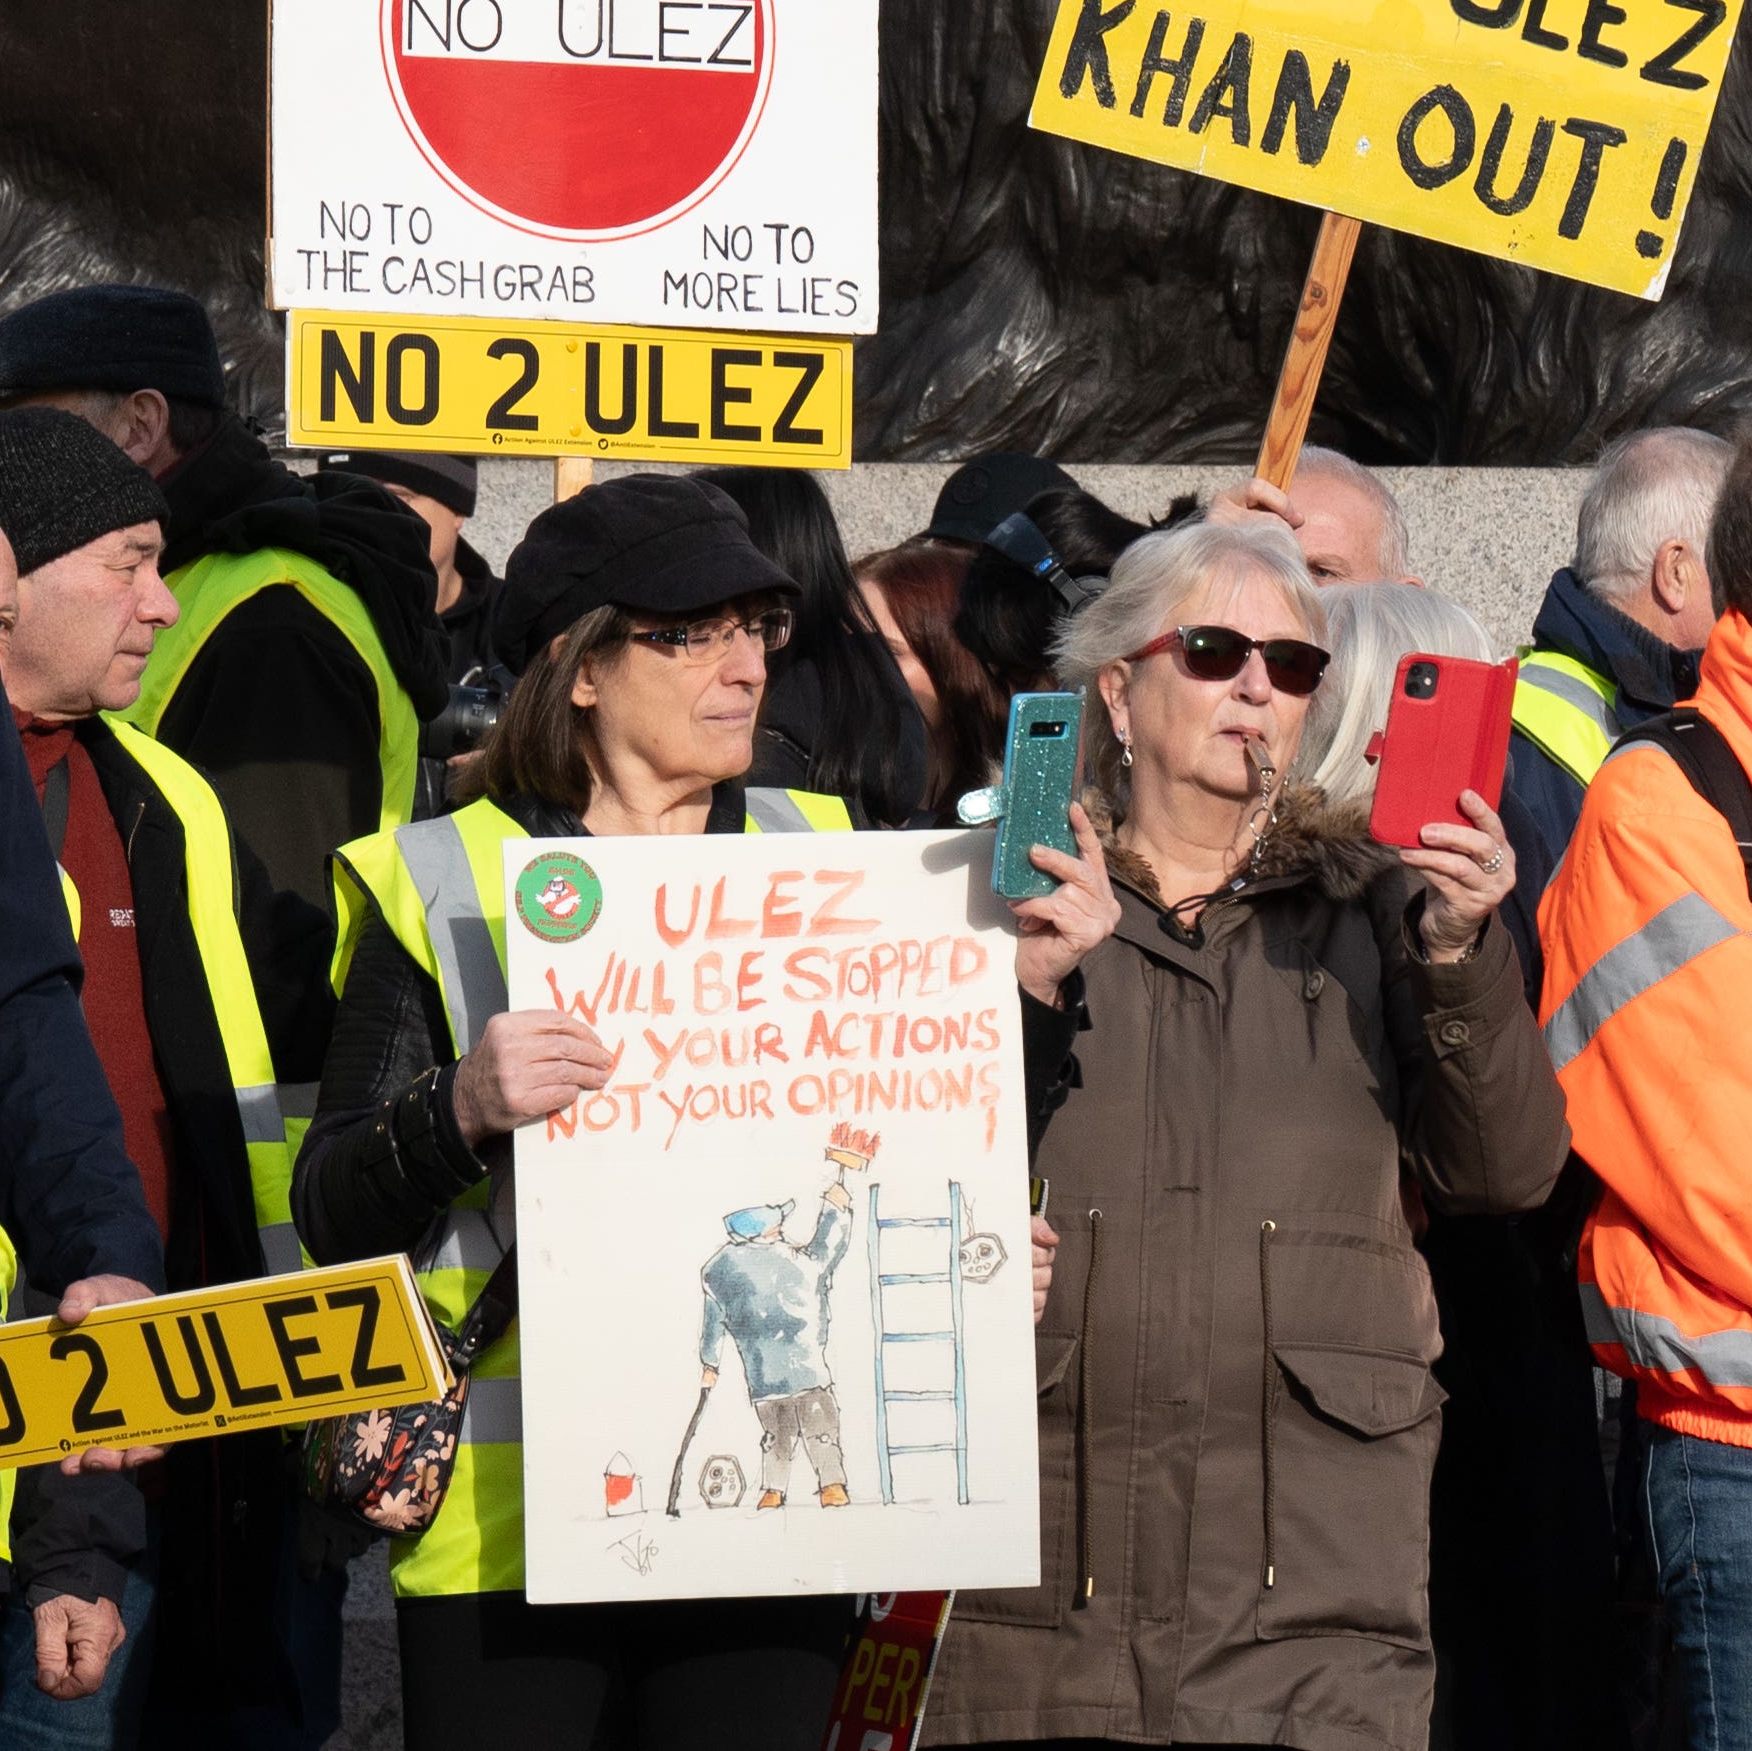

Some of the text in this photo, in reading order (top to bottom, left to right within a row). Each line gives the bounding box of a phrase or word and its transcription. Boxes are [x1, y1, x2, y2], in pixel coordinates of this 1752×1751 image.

[320, 199, 433, 246] NO TO
[703, 222, 815, 265] NO TO
[296, 247, 596, 304] THE CASH GRAB
[662, 269, 861, 318] MORE LIES
[319, 328, 825, 446] NO 2 ULEZ
[654, 869, 883, 949] ULEZ
[545, 935, 989, 1027] WILL BE STOPPED
[643, 1021, 790, 1080] YOUR
[803, 1006, 1002, 1063] ACTIONS
[546, 1082, 652, 1144] NOT
[657, 1078, 775, 1152] YOUR
[49, 1333, 127, 1434] 2
[139, 1285, 407, 1417] ULEZ
